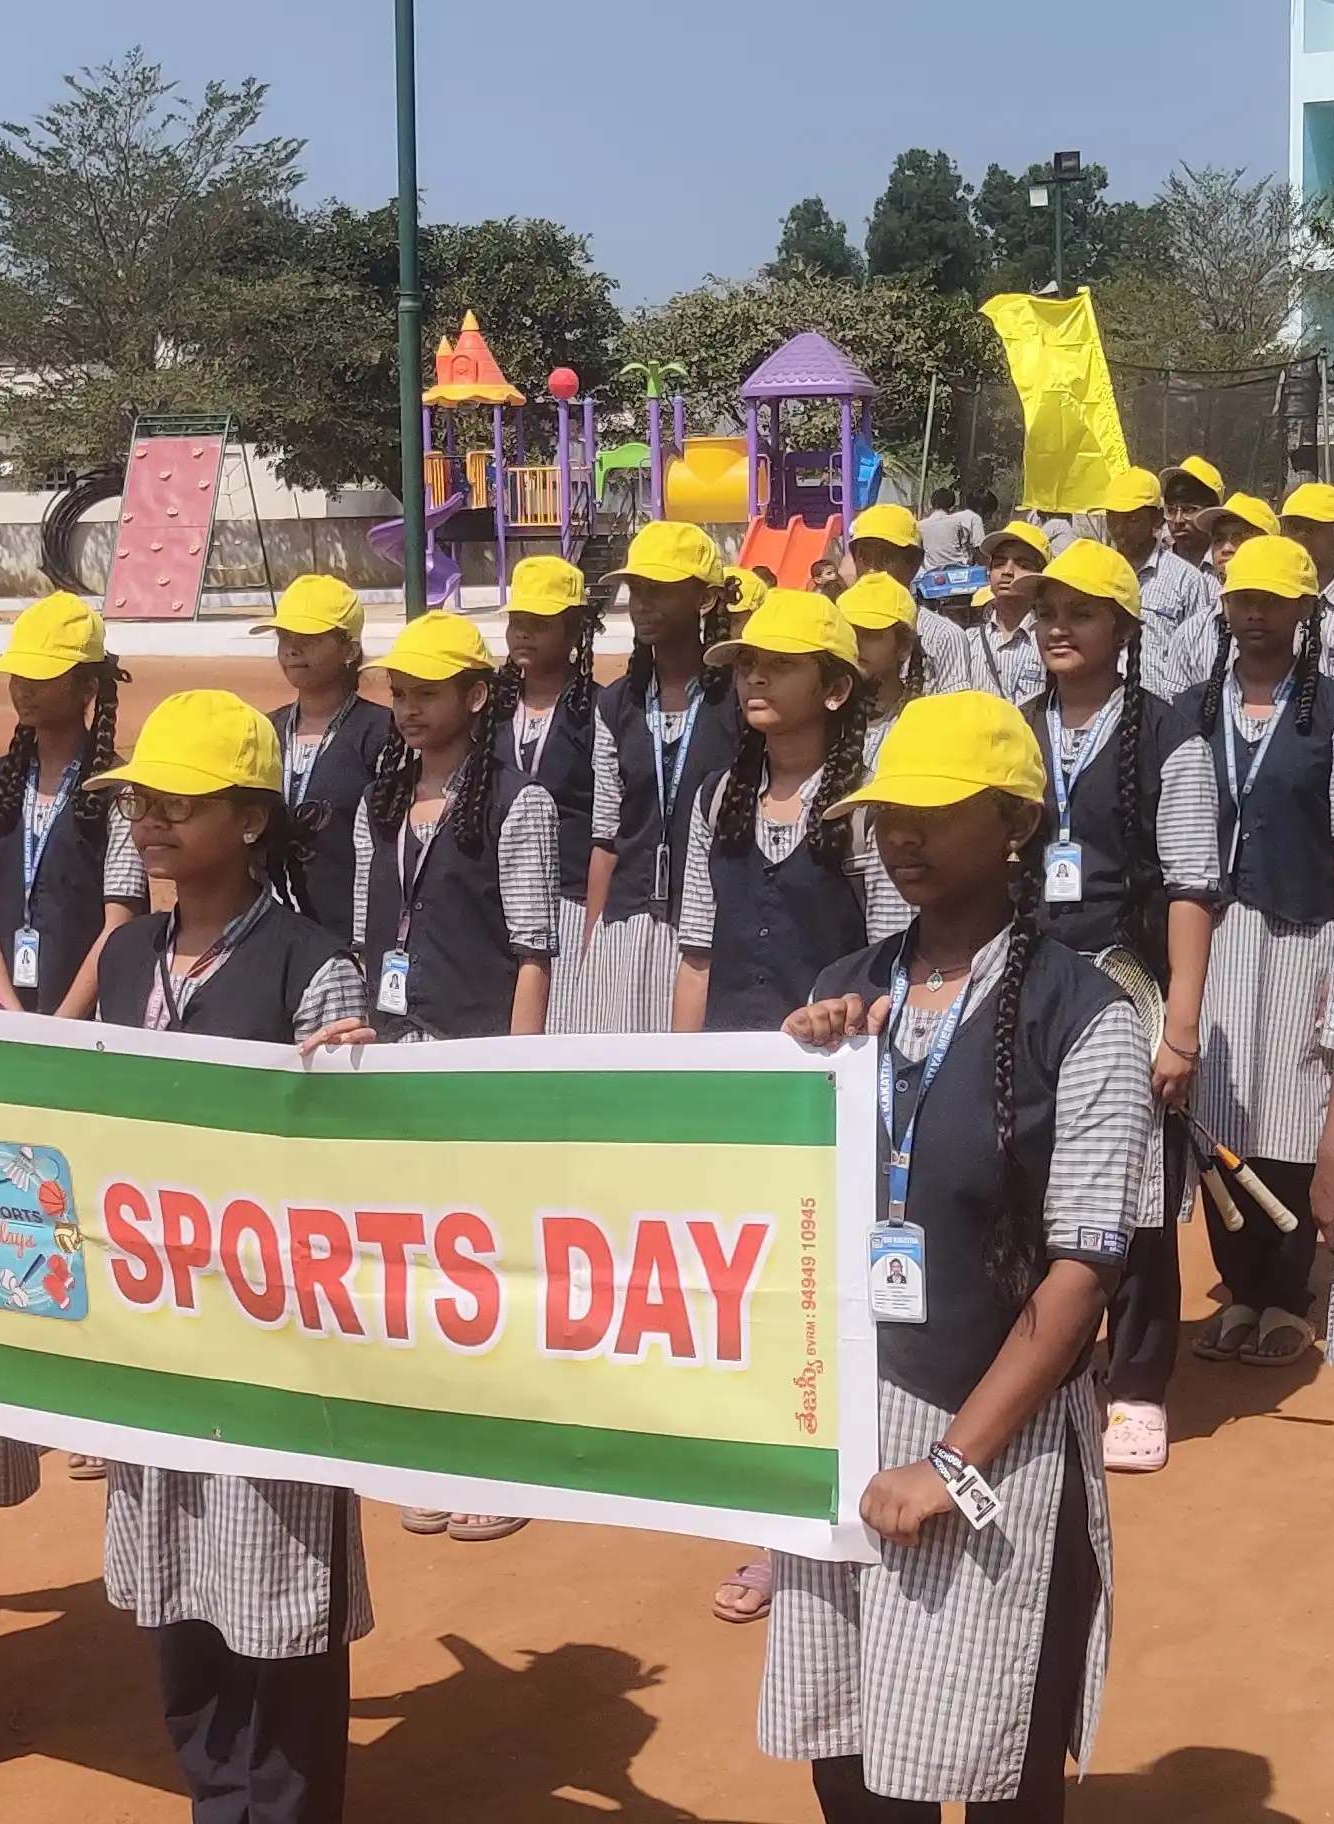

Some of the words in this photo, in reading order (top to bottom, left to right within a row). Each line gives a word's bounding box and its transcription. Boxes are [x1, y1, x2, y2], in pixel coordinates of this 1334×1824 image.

[936, 1013, 958, 1050] MERIT
[879, 1052, 892, 1113] KAKATIYA
[800, 1197, 817, 1251] 10945
[101, 1181, 500, 1347] SPORTS
[541, 1215, 771, 1361] DAY
[801, 1255, 817, 1311] 94949
